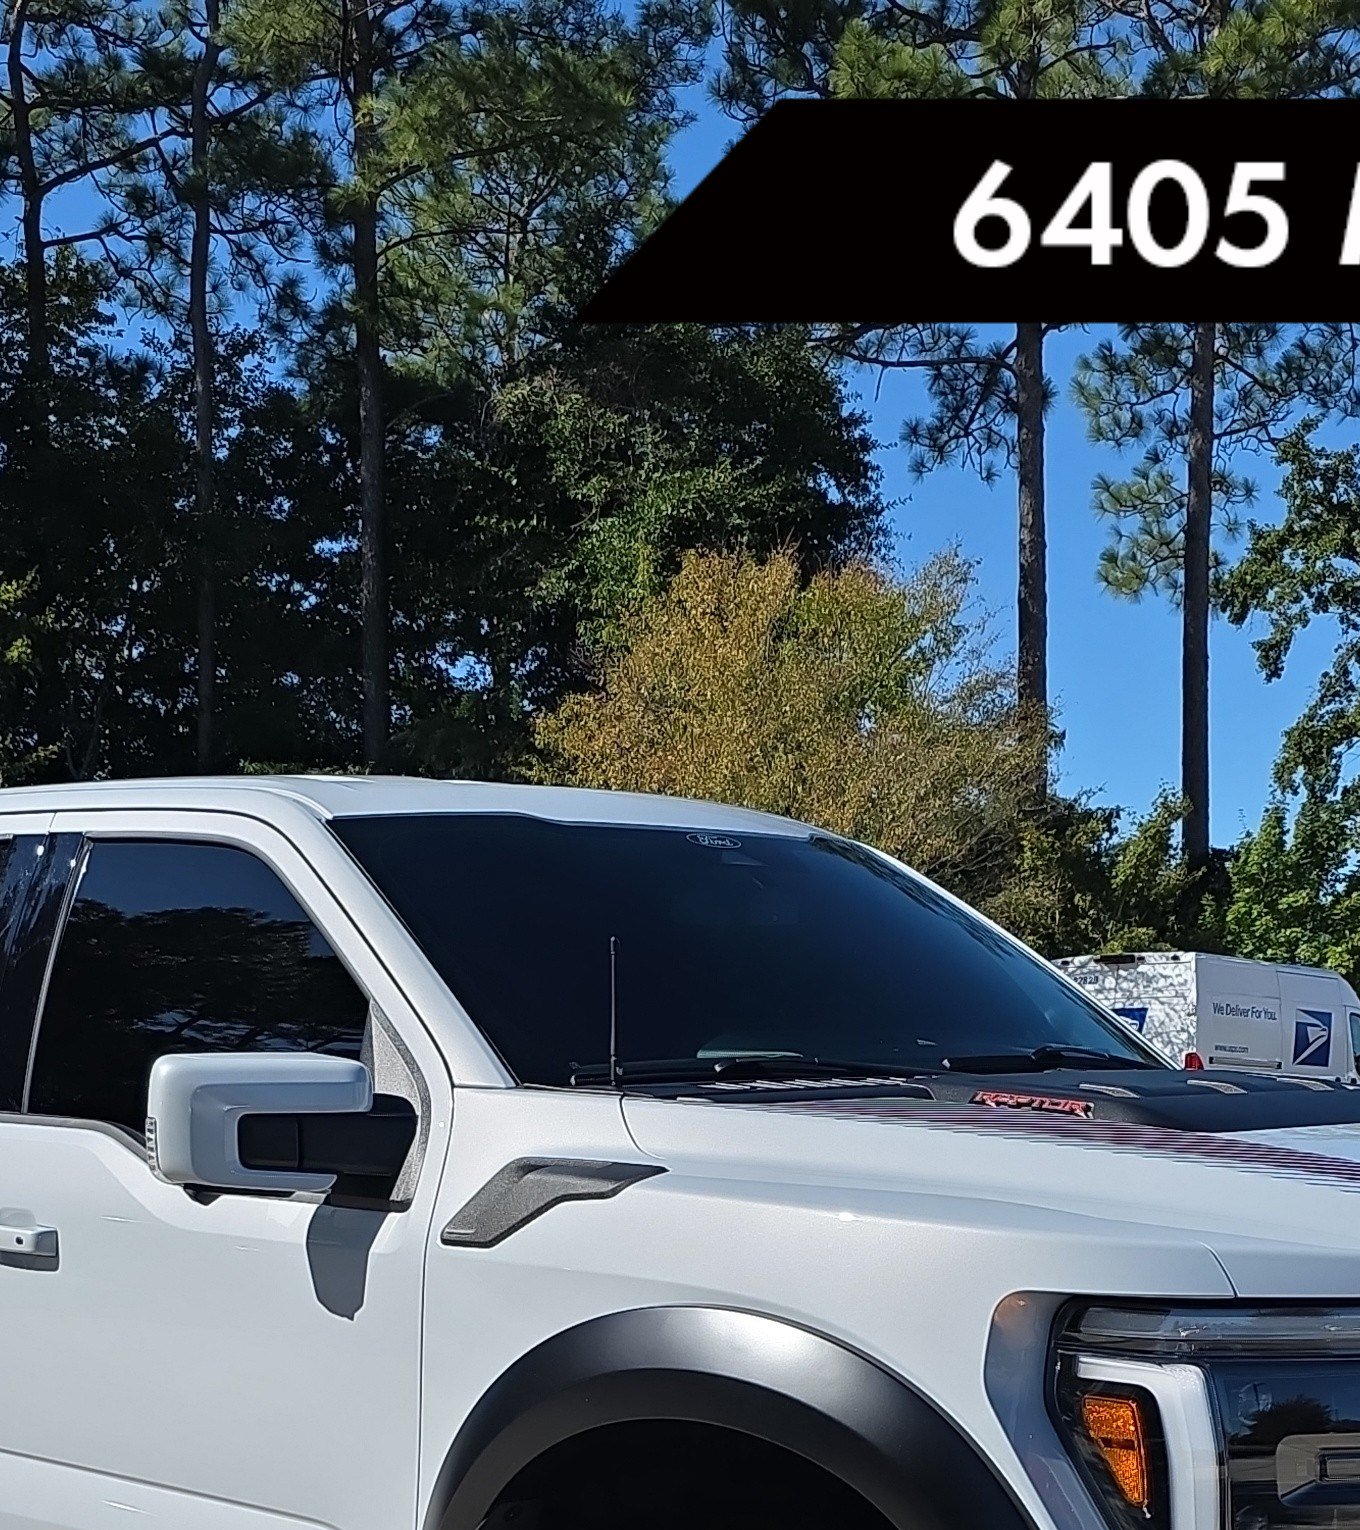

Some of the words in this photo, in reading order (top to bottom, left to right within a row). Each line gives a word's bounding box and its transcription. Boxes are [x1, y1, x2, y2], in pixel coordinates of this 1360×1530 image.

[1213, 1002, 1224, 1016] We
[1225, 1003, 1250, 1018] Deliver
[1251, 1006, 1262, 1019] For
